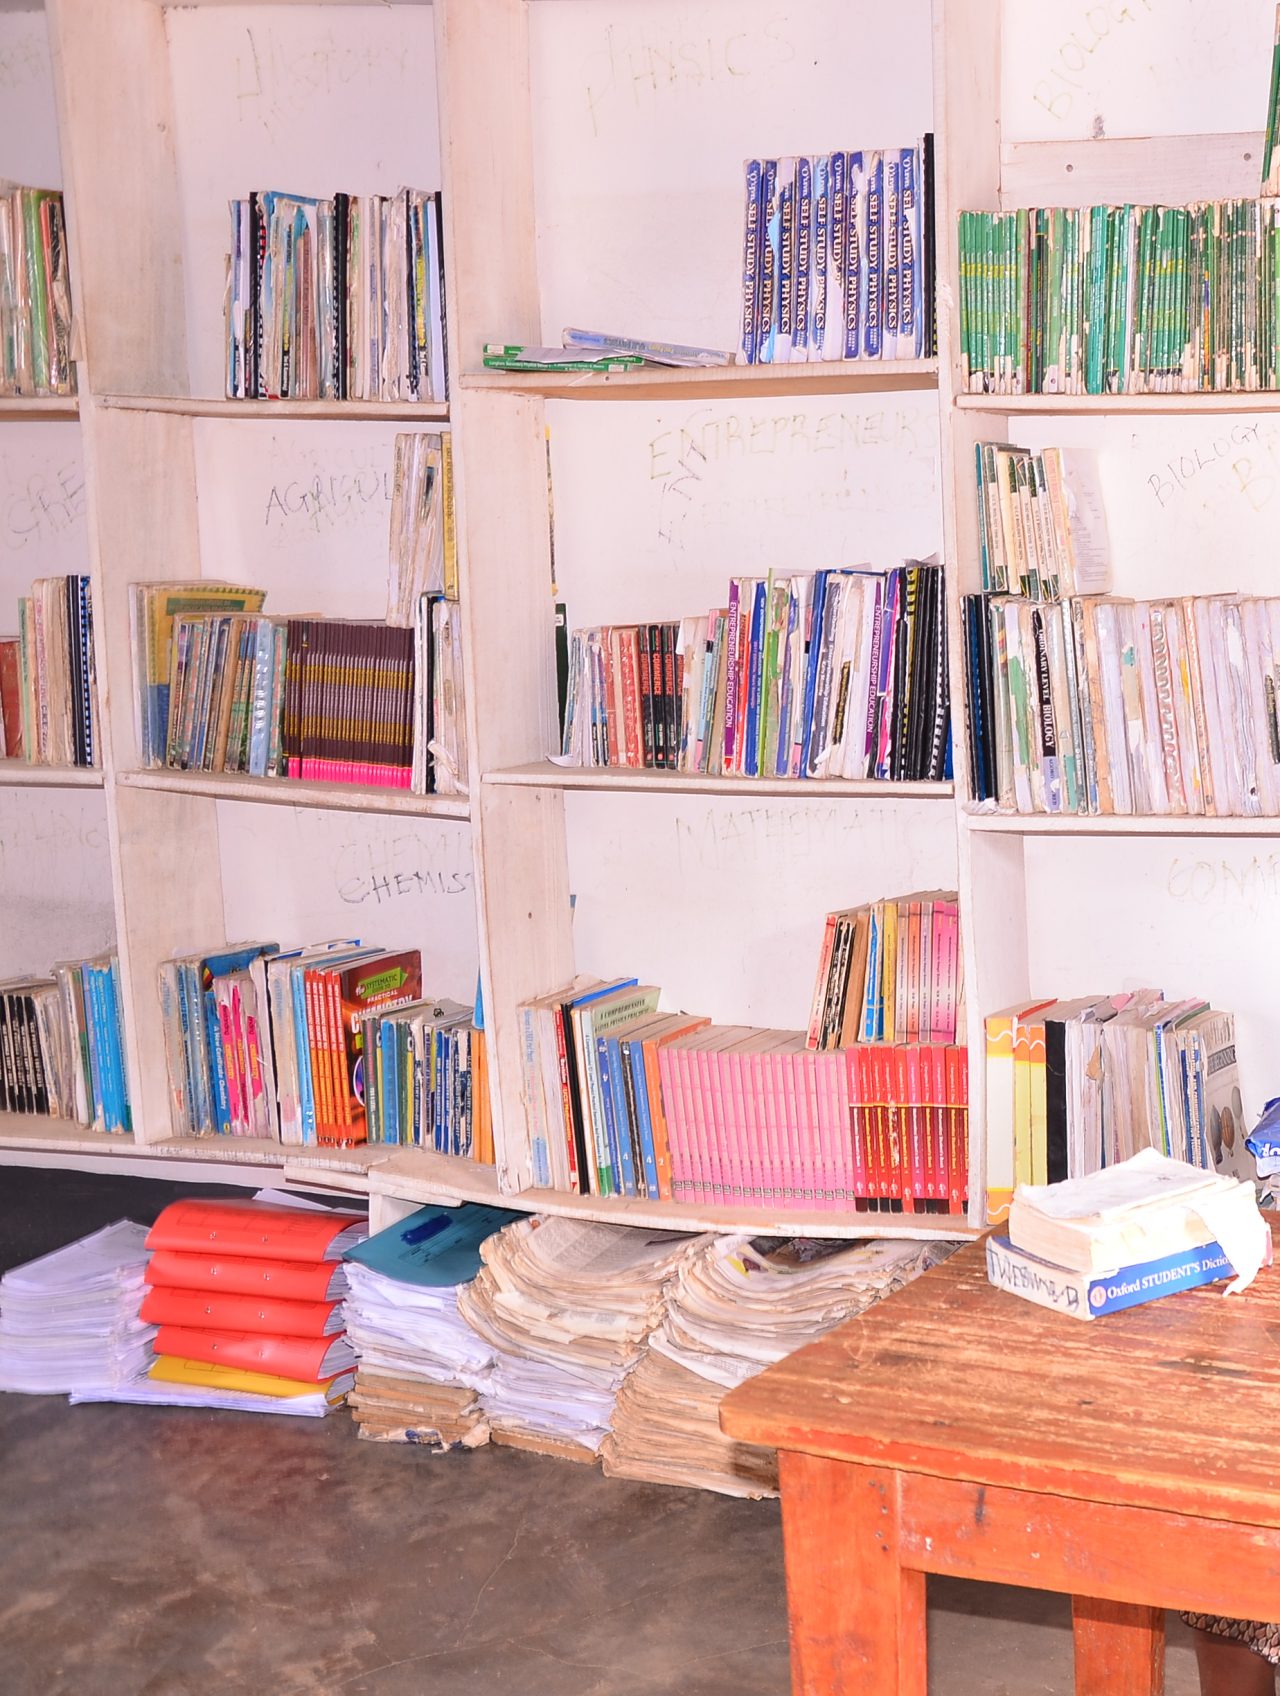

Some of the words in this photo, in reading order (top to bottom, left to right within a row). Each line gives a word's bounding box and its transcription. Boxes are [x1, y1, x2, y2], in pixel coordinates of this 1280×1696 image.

[1034, 0, 1152, 120] BIOLOG
[747, 203, 758, 230] SELF
[782, 202, 792, 229] SELF
[799, 198, 810, 226] SELF
[816, 197, 827, 225] SELF
[833, 193, 843, 220] SELF
[868, 195, 879, 223] SELF
[746, 234, 757, 277] STUDY
[781, 233, 791, 276] STUDY
[799, 230, 809, 273] STUDY
[816, 228, 827, 271] STUDY
[833, 223, 843, 267] STUDY
[848, 228, 859, 272] STUDY
[868, 226, 879, 270] STUDY
[887, 227, 898, 270] STUDY
[902, 222, 914, 267] STUDY
[744, 281, 755, 333] PHYSICS
[762, 280, 773, 333] PHYSICS
[780, 280, 791, 333] PHYSICS
[796, 277, 808, 330] PHYSICS
[815, 275, 826, 329] PHYSICS
[847, 276, 859, 330] PHYSICS
[867, 274, 879, 327] PHYSICS
[886, 275, 898, 328] PHYSICS
[902, 270, 914, 323] PHYSICS
[1147, 422, 1260, 508] BIOLOGY
[726, 601, 737, 680] ENTREPRENEURSHIP
[869, 605, 882, 685] ENTREPRENEURSHIP
[1038, 629, 1048, 672] ORDINARY
[640, 653, 650, 696] COMMERCE
[652, 653, 662, 696] COMMERCE
[664, 653, 674, 696] COMMERCE
[1041, 673, 1050, 701] LEVEL
[725, 682, 735, 728] EDUCATION
[866, 686, 878, 733] EDUCATION
[1042, 705, 1055, 747] BIOLOGY
[338, 870, 473, 904] CHEMIS
[366, 974, 399, 989] SYSTEMATIC
[367, 990, 398, 1003] PRACTICAL
[215, 1048, 224, 1078] Certificate
[218, 1080, 228, 1110] Chemistry
[465, 1074, 473, 1109] CHEMISTRY
[564, 1104, 572, 1141] Mathematics
[1107, 1281, 1141, 1299] Oxford
[1142, 1262, 1200, 1289] STUDENT'S
[1202, 1253, 1230, 1275] Dictio
